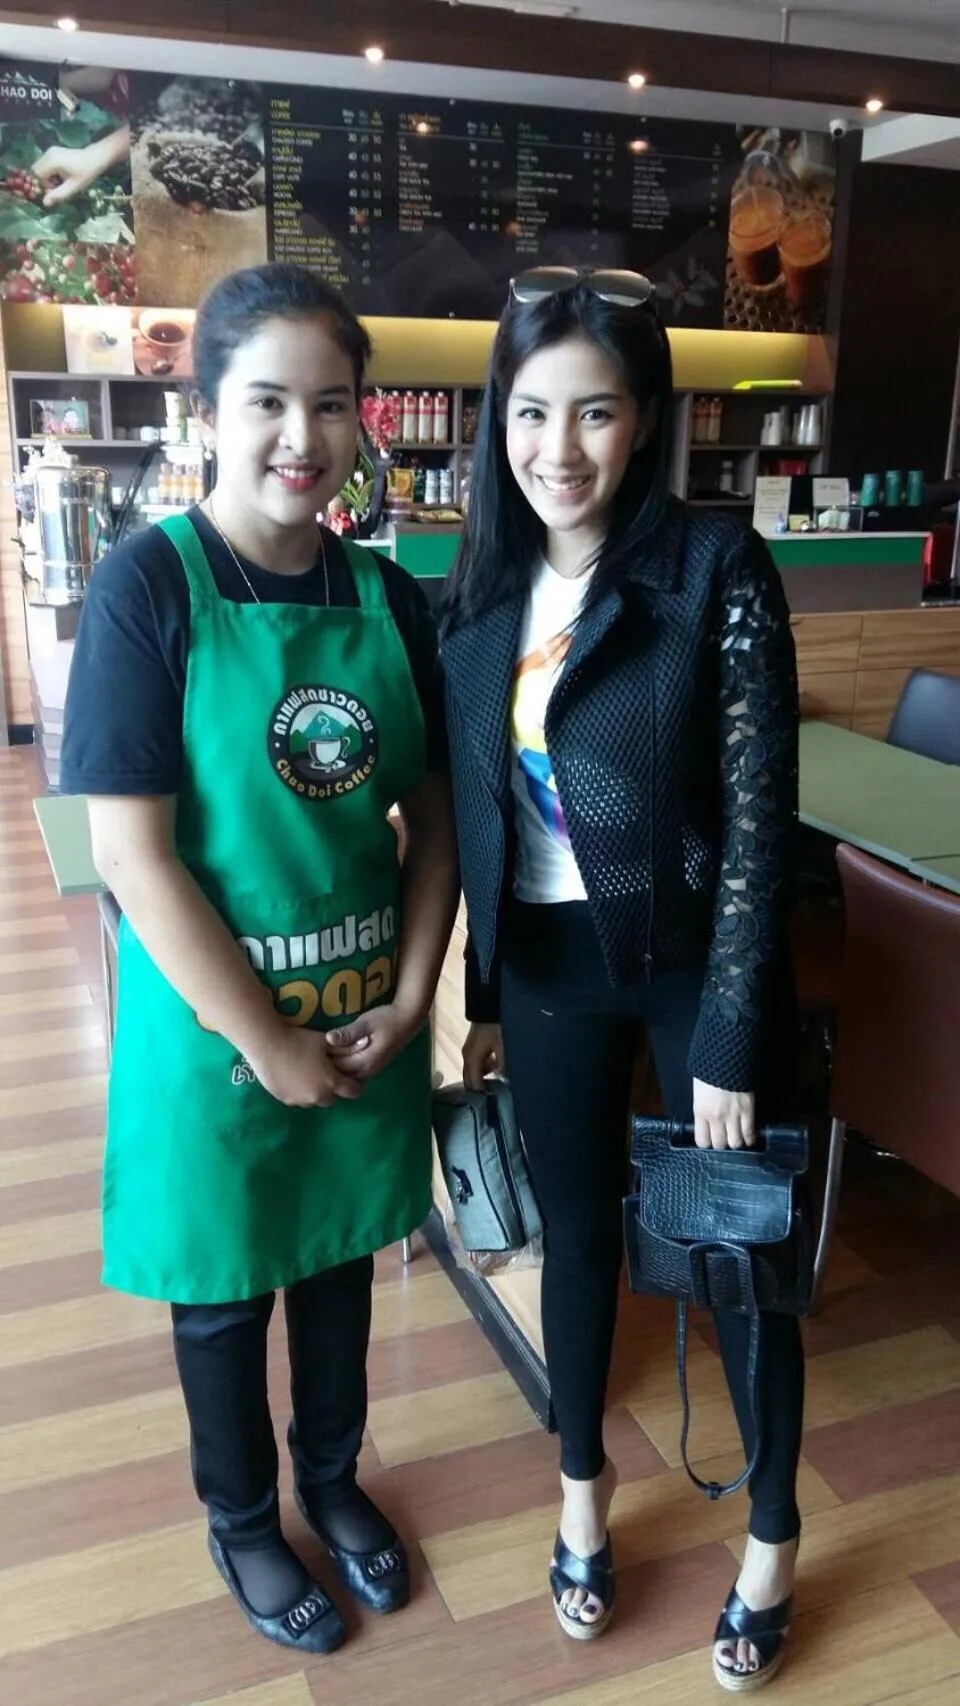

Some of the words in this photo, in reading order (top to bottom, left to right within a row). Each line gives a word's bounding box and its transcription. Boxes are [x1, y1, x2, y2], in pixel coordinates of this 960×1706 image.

[31, 87, 52, 100] DOI
[276, 758, 306, 793] Chao
[308, 783, 332, 798] Doi
[334, 754, 375, 794] Coffee
